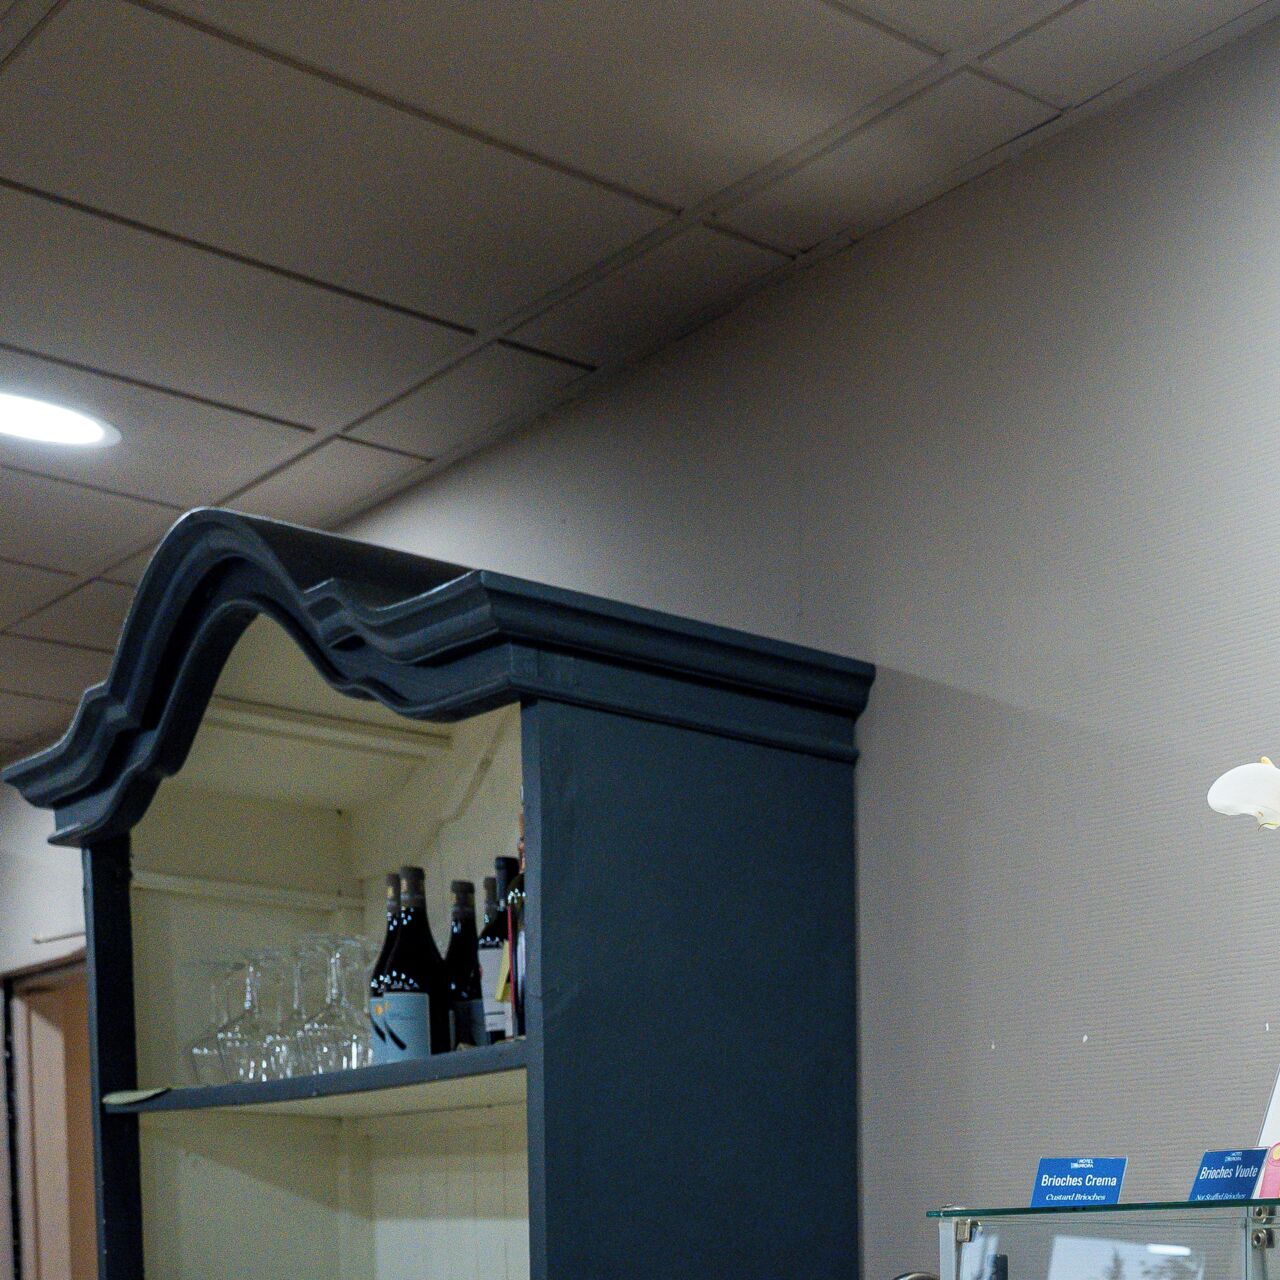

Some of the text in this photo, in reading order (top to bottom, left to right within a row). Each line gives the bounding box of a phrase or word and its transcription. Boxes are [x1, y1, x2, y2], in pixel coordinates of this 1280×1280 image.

[1200, 1164, 1258, 1180] Brioches Vuote
[1041, 1174, 1117, 1187] Brioches Crema
[1046, 1193, 1106, 1201] Custard Brioches
